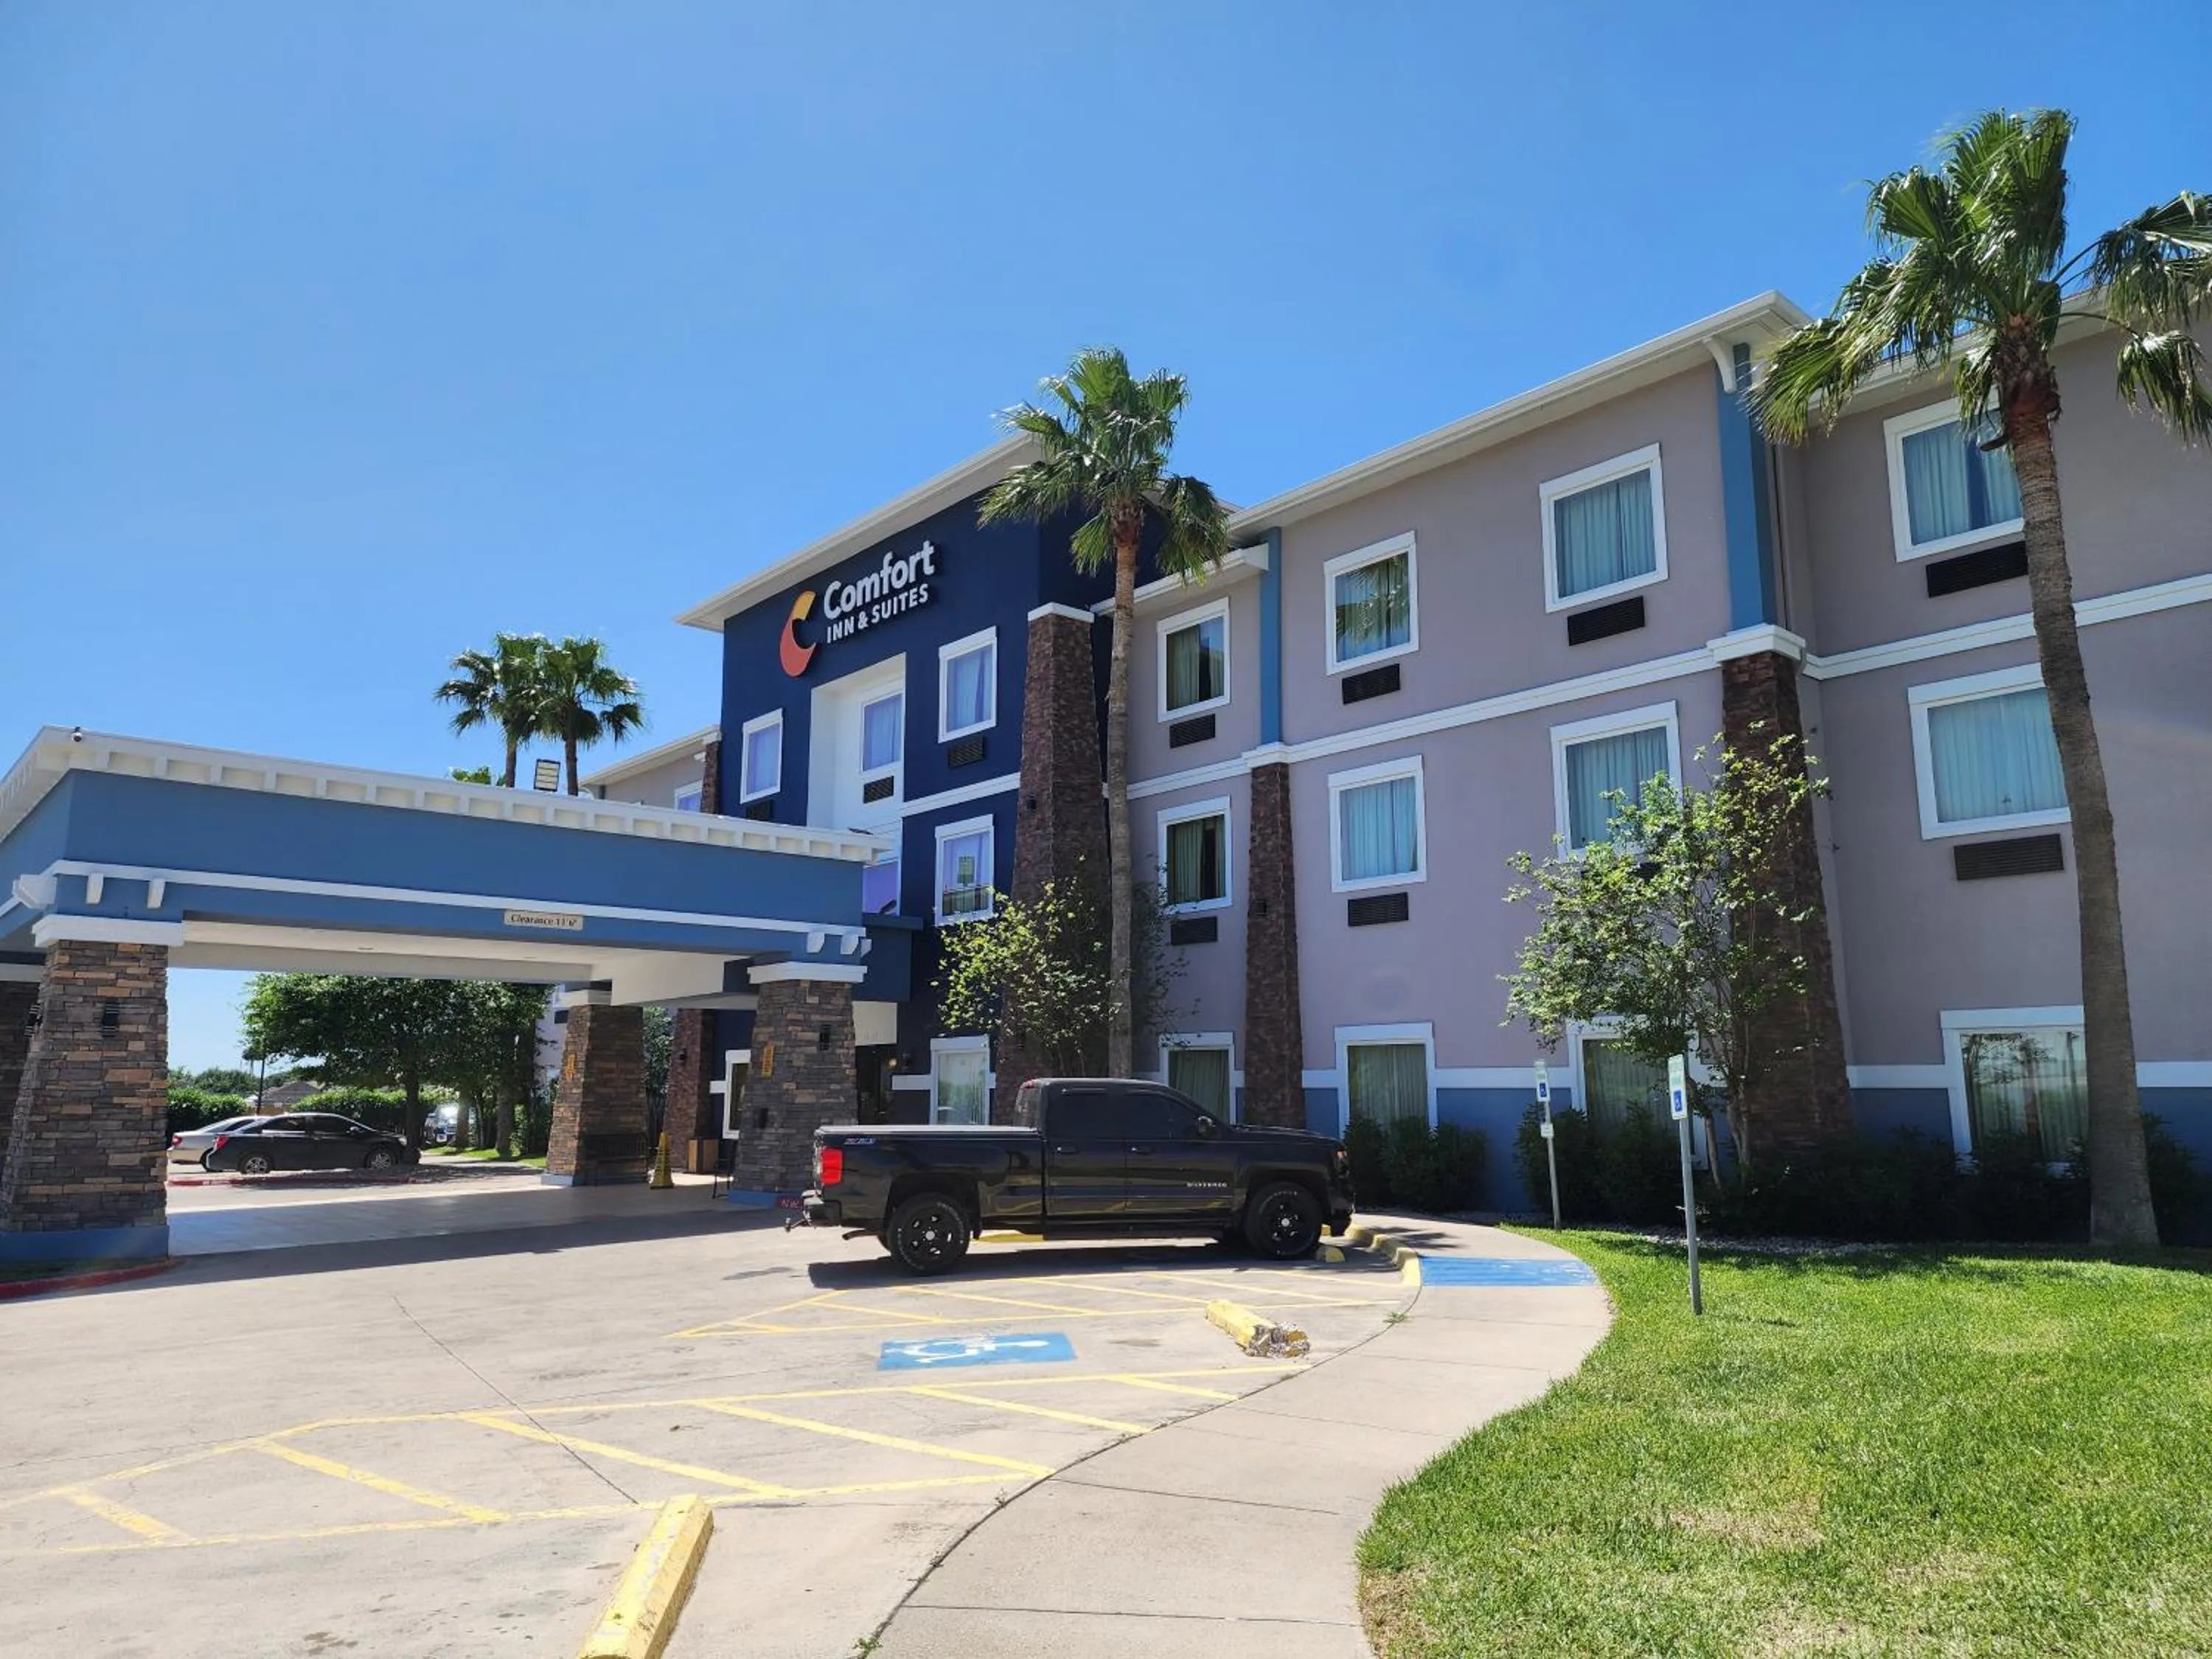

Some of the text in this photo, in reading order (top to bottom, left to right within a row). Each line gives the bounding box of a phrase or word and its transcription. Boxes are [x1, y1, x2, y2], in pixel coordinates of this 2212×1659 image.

[823, 540, 936, 620] Comfort
[827, 582, 929, 644] INN & SUITES
[510, 914, 554, 925] Clearance
